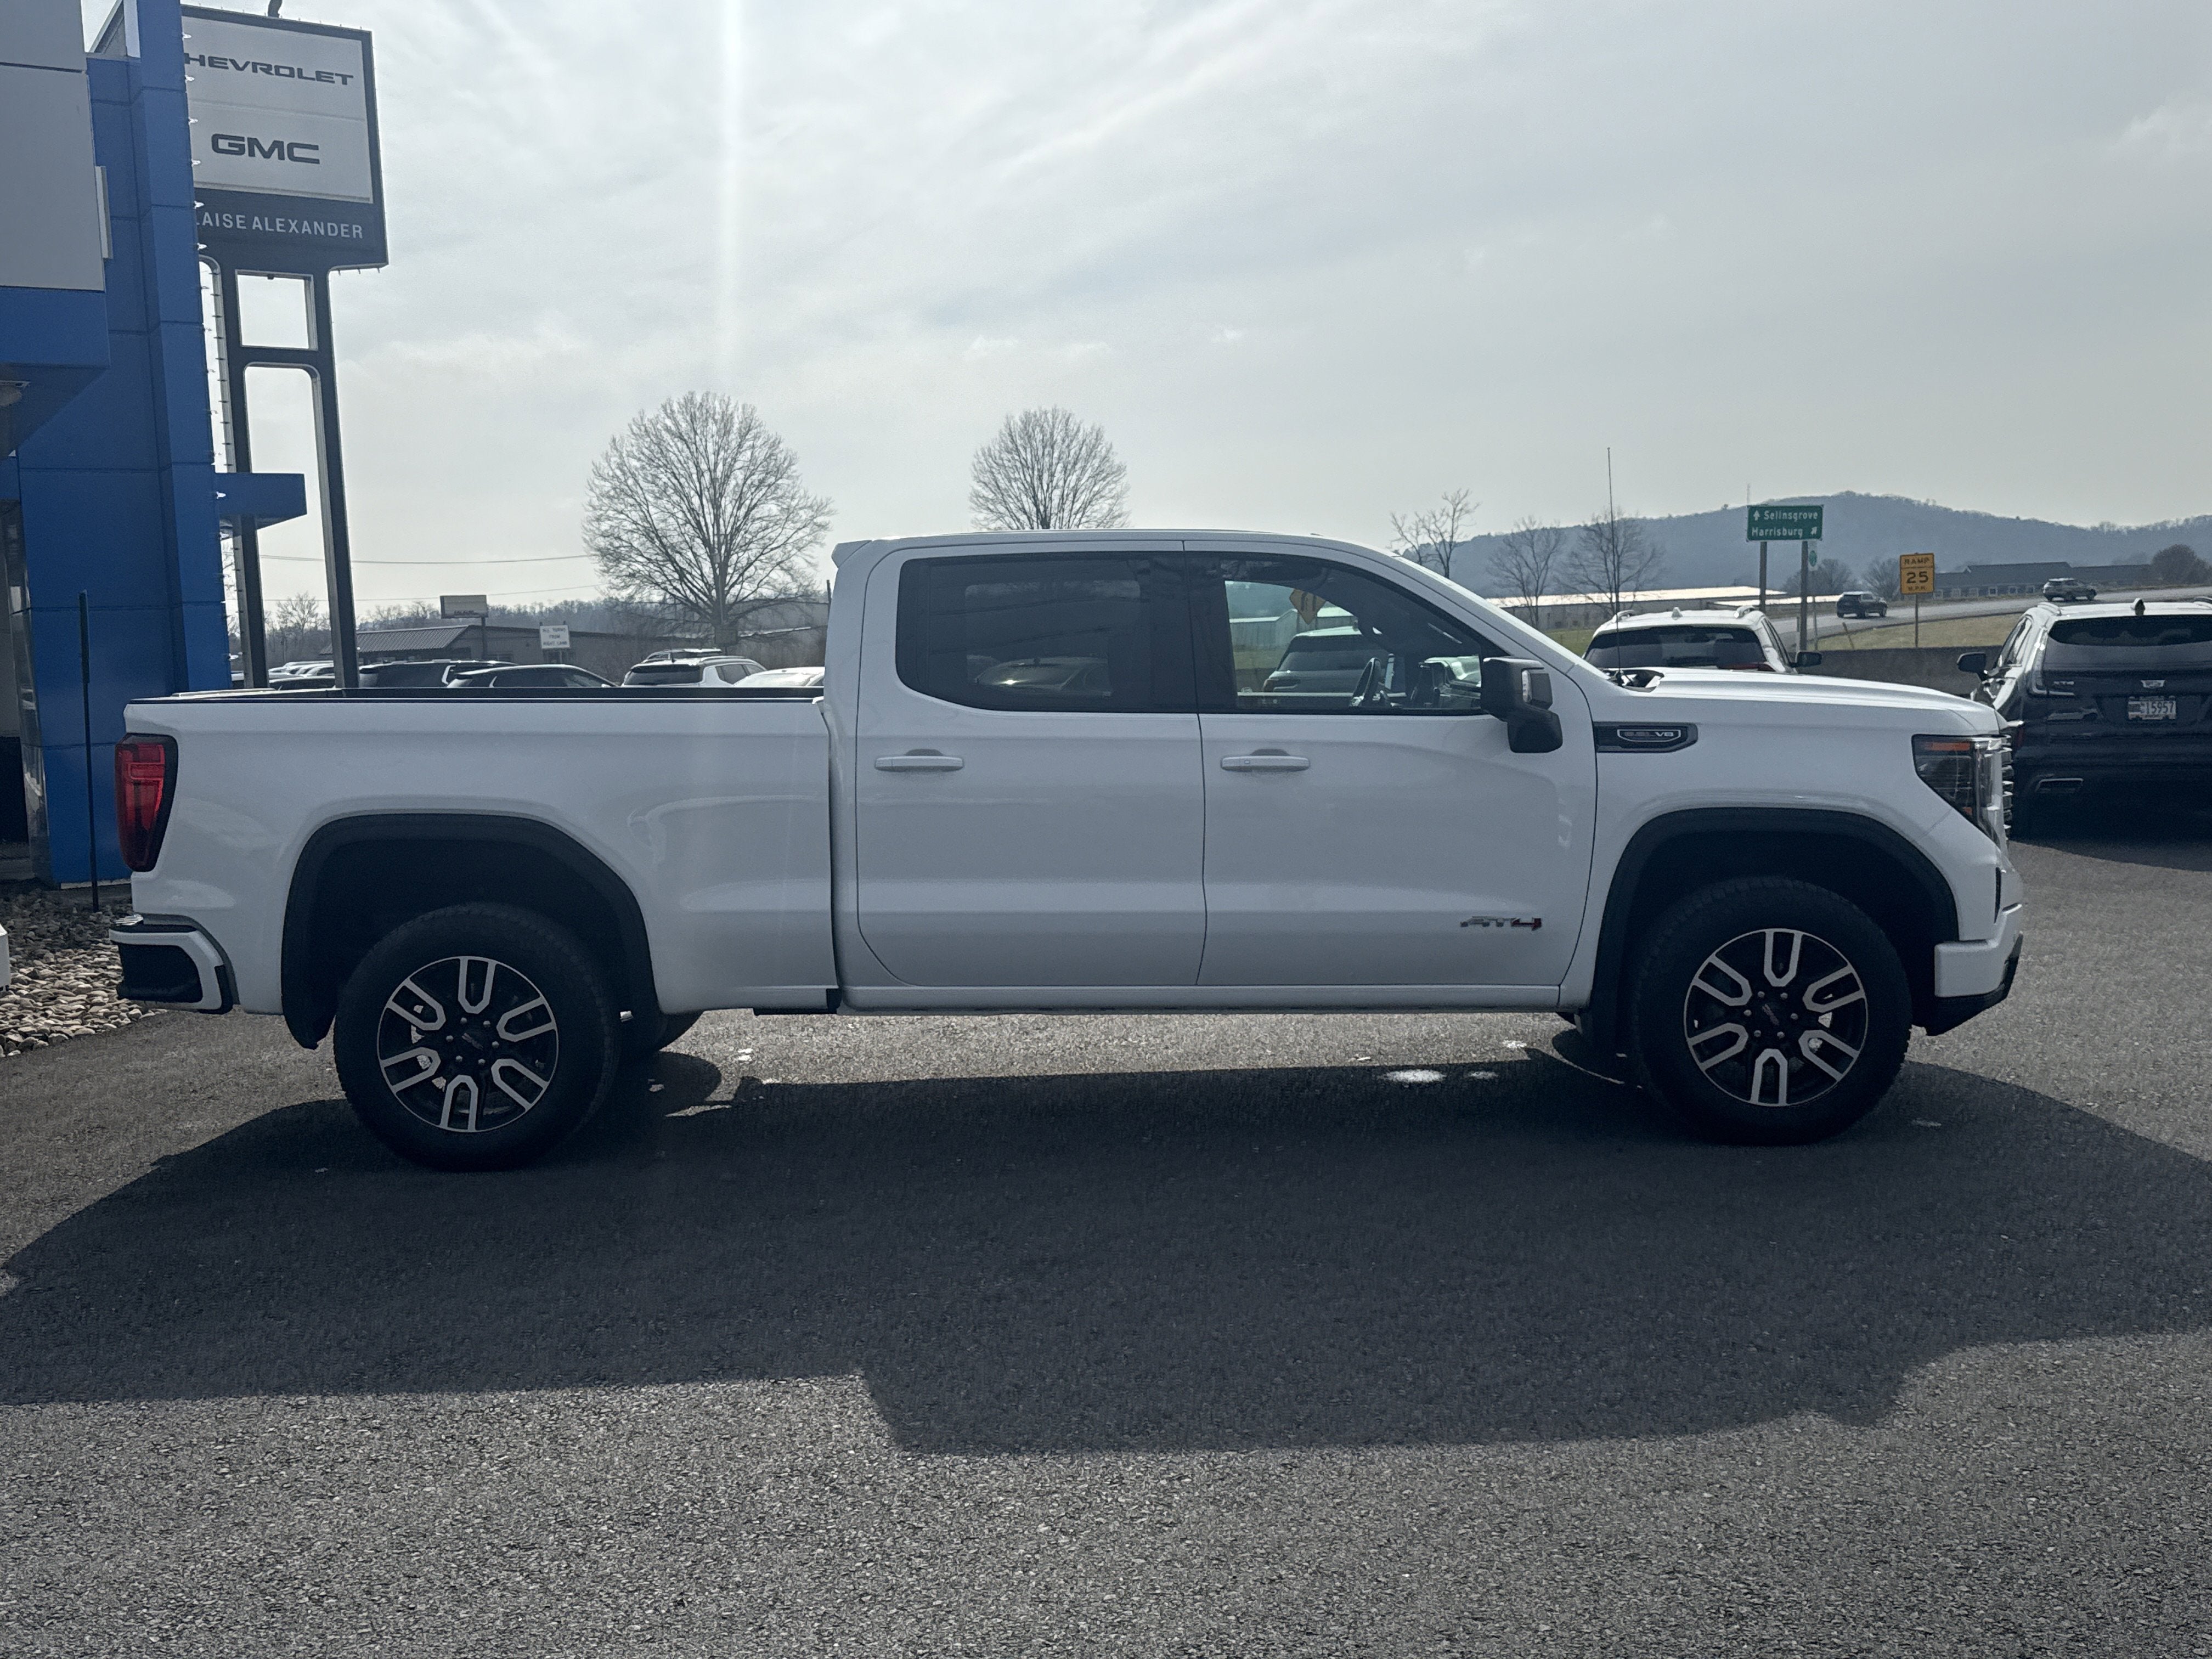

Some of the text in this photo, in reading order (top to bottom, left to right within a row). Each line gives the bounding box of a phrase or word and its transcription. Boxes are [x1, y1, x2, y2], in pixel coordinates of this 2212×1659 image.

[183, 53, 354, 86] HEVROLET
[211, 133, 320, 165] GMC
[196, 212, 363, 239] AISE ALEXANDER
[1764, 510, 1818, 522] Selinsgrove
[1751, 527, 1803, 539] Harrisburg
[1904, 557, 1929, 565] RAMP
[1905, 571, 1929, 584] 25
